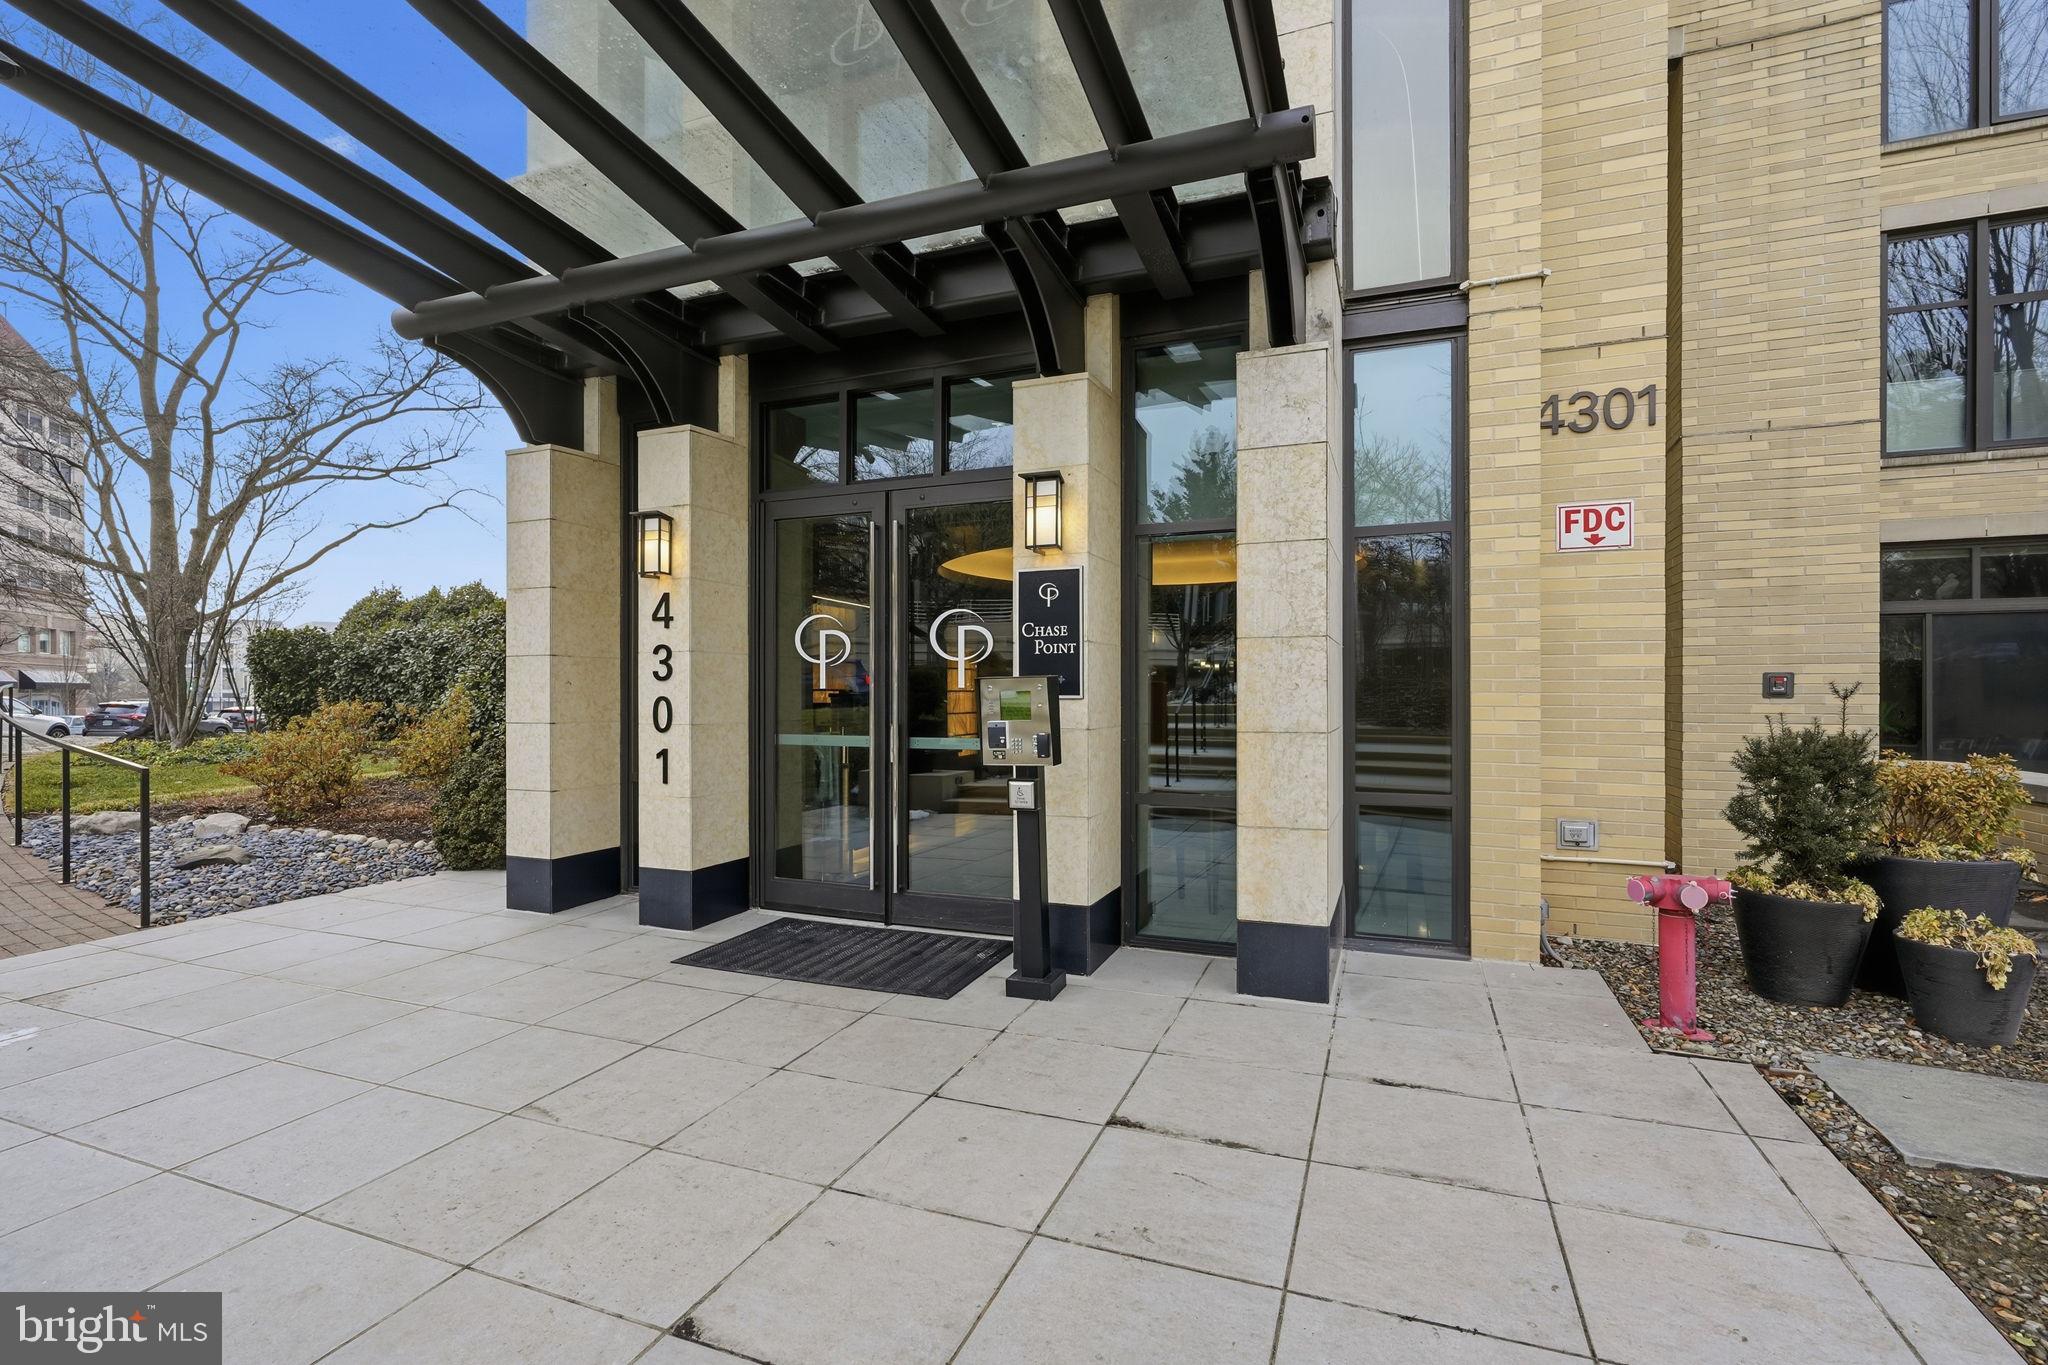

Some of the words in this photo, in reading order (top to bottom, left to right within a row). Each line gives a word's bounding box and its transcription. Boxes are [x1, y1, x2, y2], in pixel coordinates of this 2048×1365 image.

[1541, 384, 1657, 436] 4301
[1564, 506, 1625, 534] FDC
[1021, 622, 1069, 638] CHASE
[1034, 639, 1077, 655] POINT
[651, 592, 675, 785] 4301
